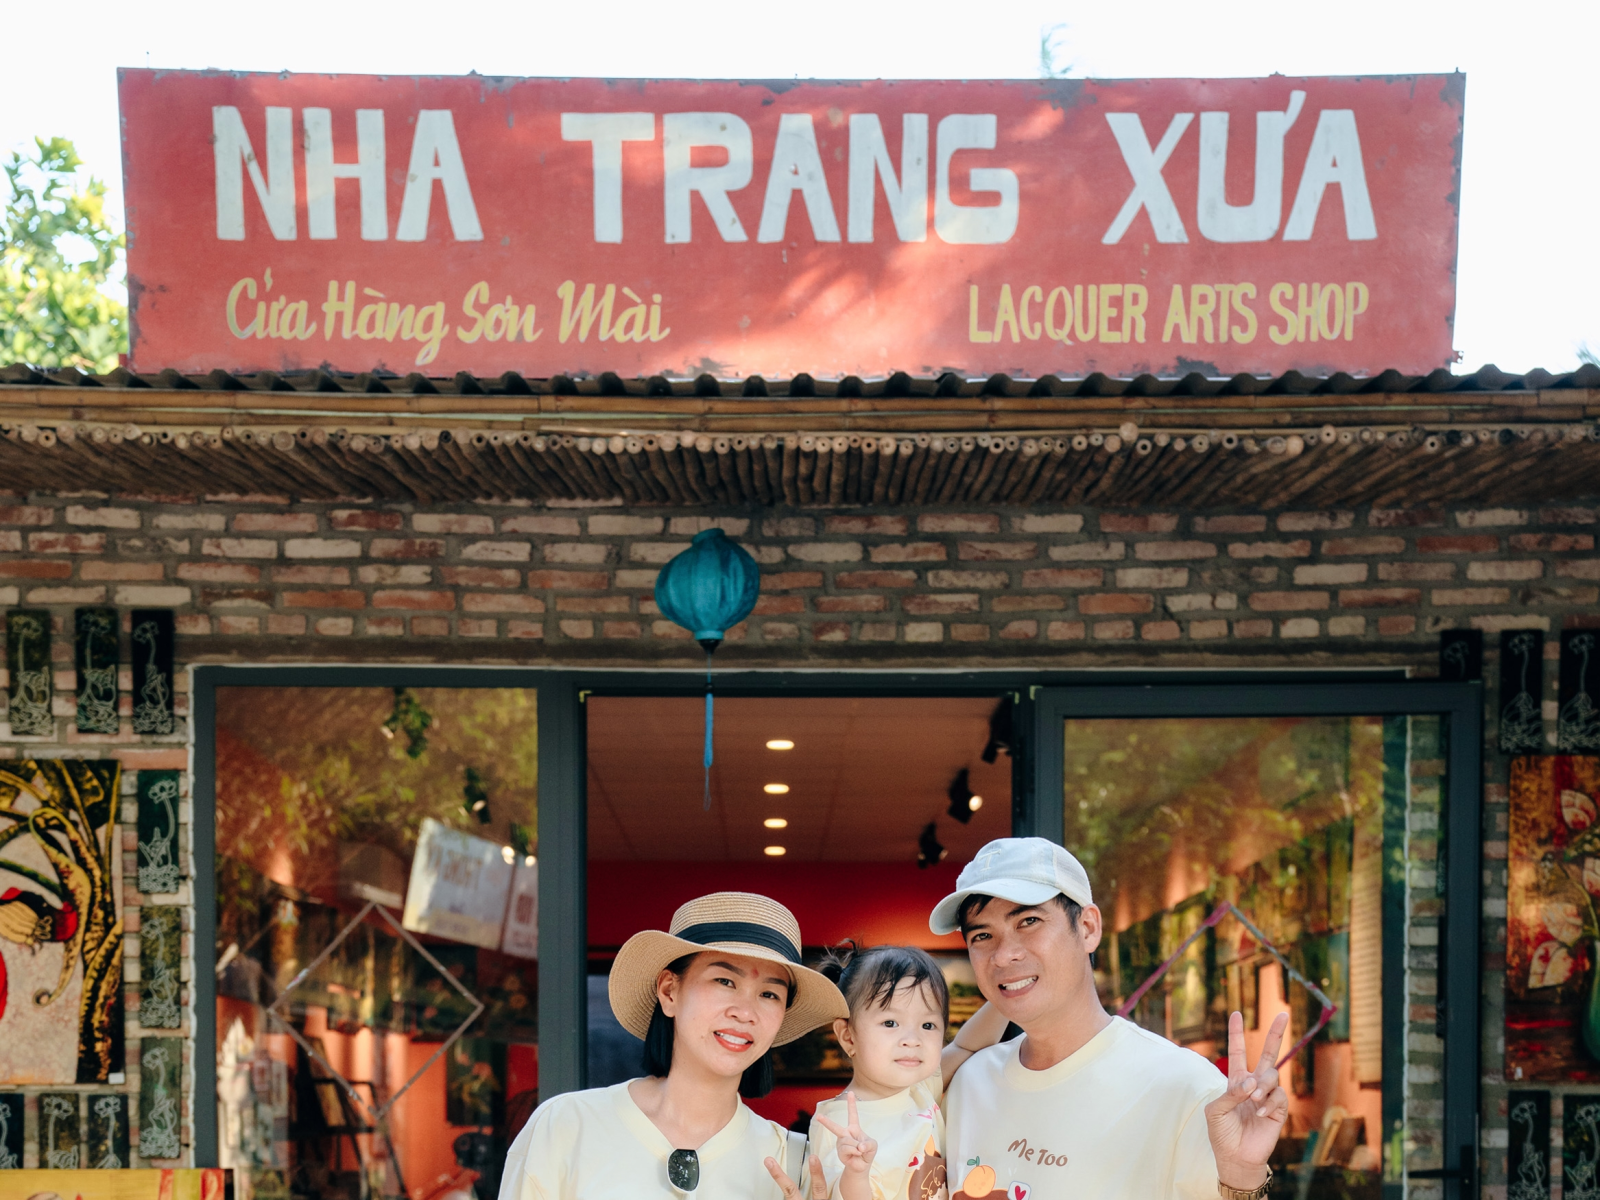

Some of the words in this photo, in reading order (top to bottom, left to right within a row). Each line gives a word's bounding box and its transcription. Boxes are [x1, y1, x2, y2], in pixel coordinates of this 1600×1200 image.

[212, 105, 484, 241] NHA
[560, 112, 1019, 245] TRANG
[1101, 89, 1378, 245] XƯA
[321, 280, 450, 366] Hàng
[456, 281, 543, 343] Sơn
[557, 279, 671, 343] Mài
[969, 284, 1146, 345] LACQUER
[1162, 282, 1257, 344] ARTS
[1268, 281, 1369, 346] SHOP
[1007, 1138, 1035, 1162] Me
